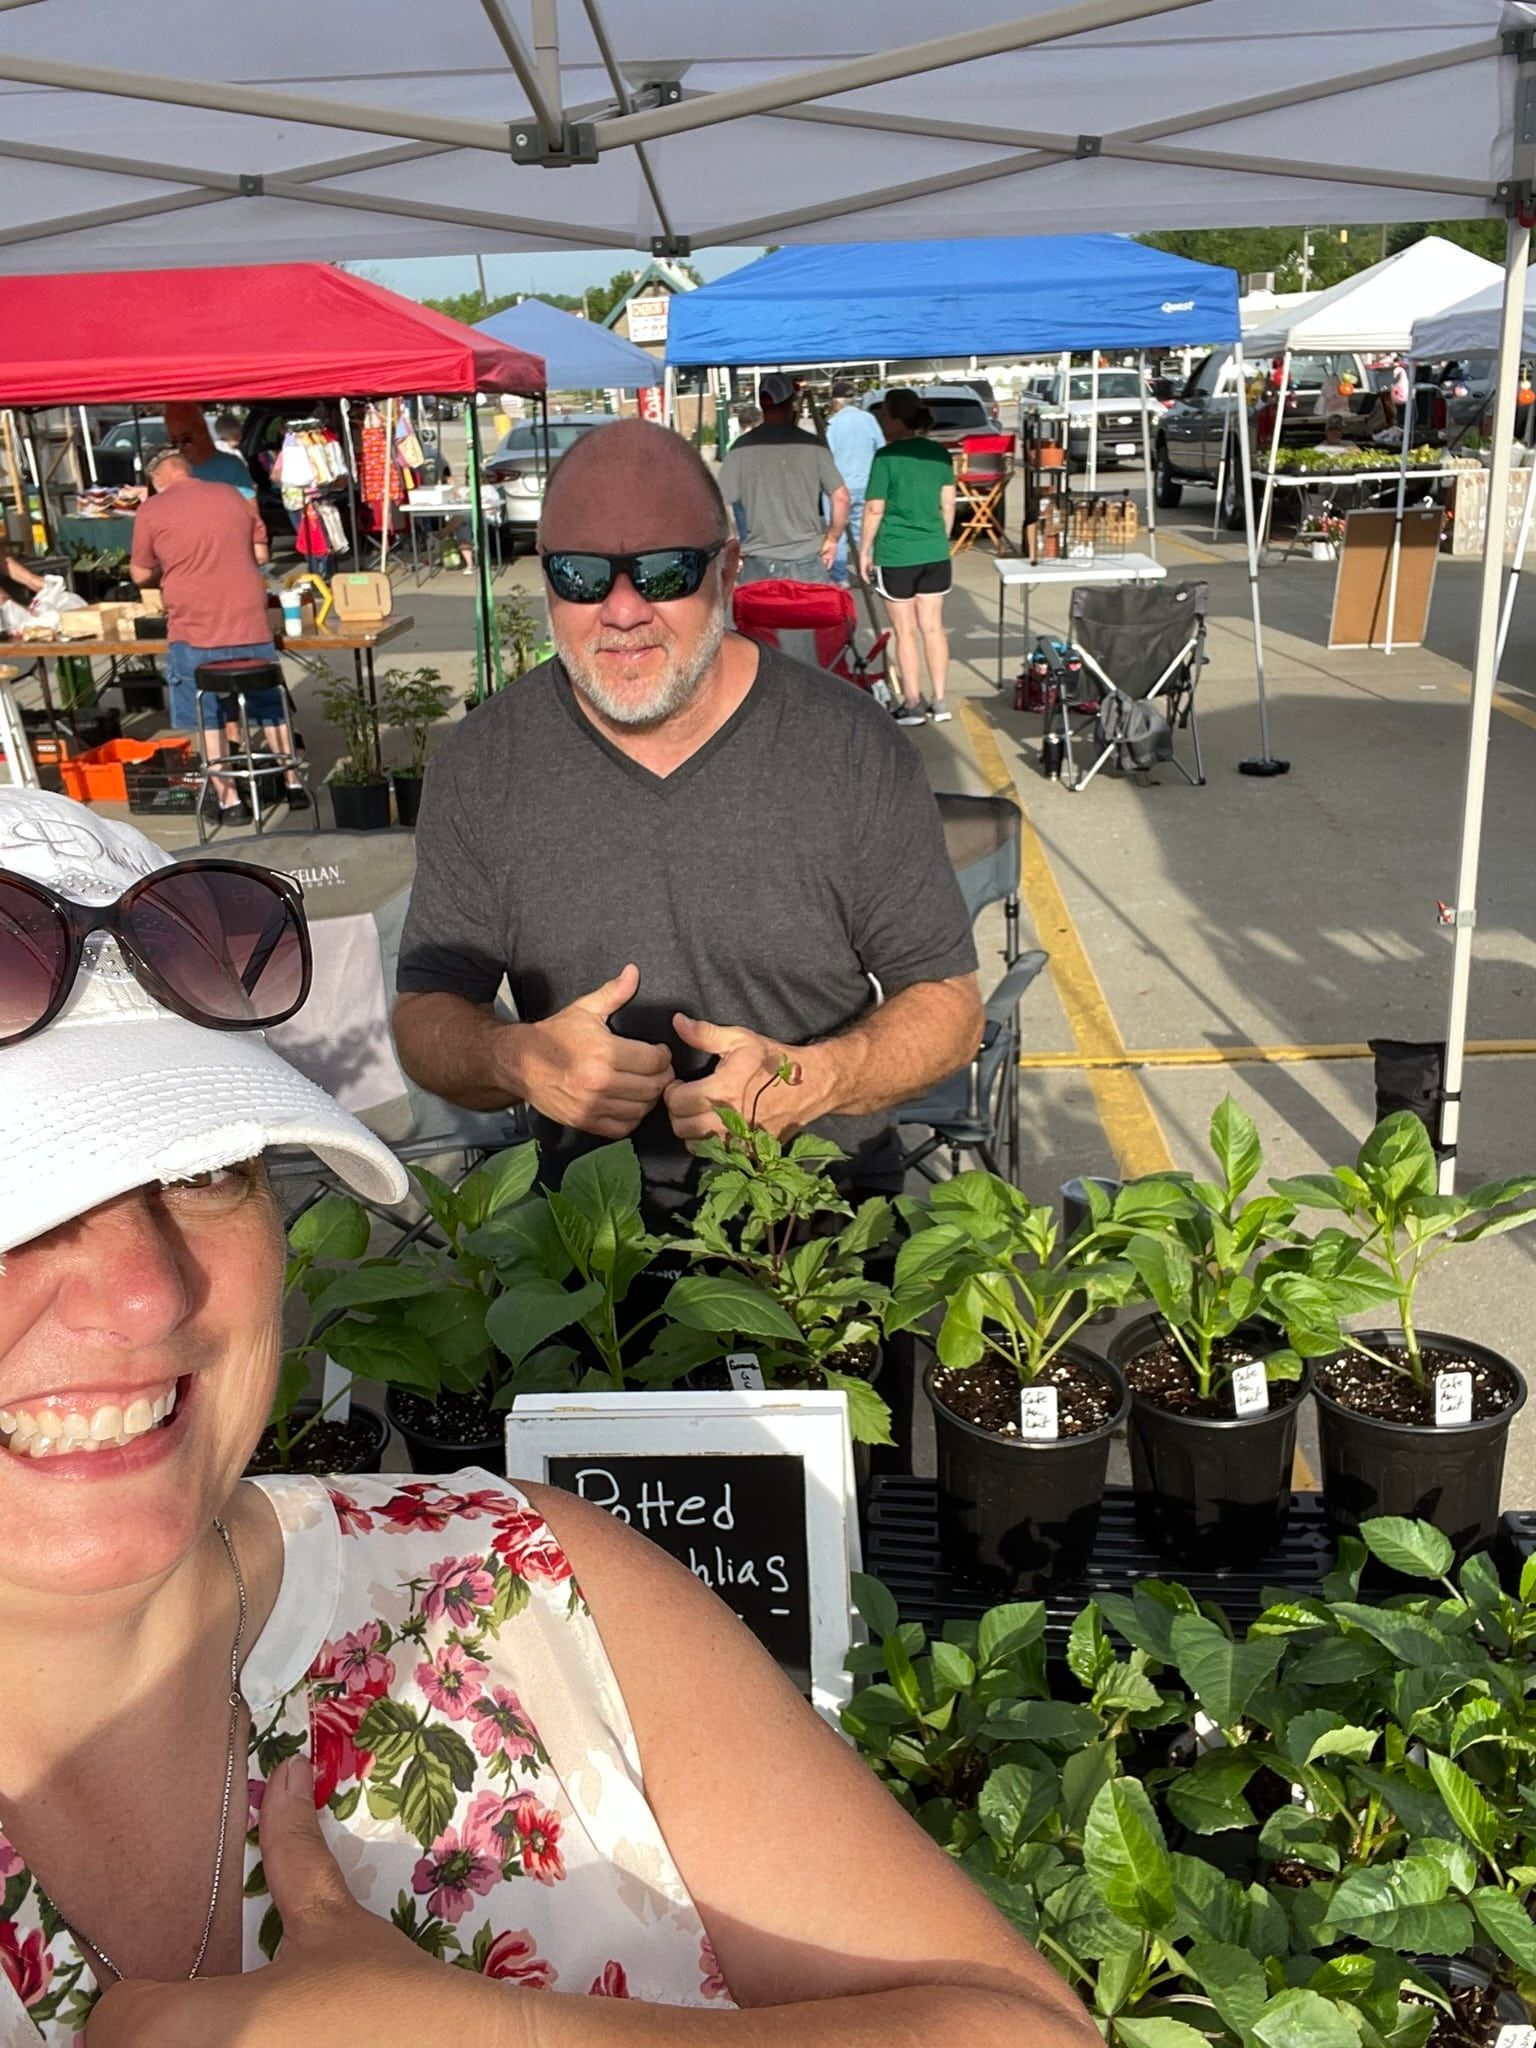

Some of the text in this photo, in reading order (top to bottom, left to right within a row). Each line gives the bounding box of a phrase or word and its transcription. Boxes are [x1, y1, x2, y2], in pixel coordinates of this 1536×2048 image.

[284, 865, 340, 882] GELLAN
[575, 1468, 735, 1531] Potted
[688, 1545, 790, 1593] hlias
